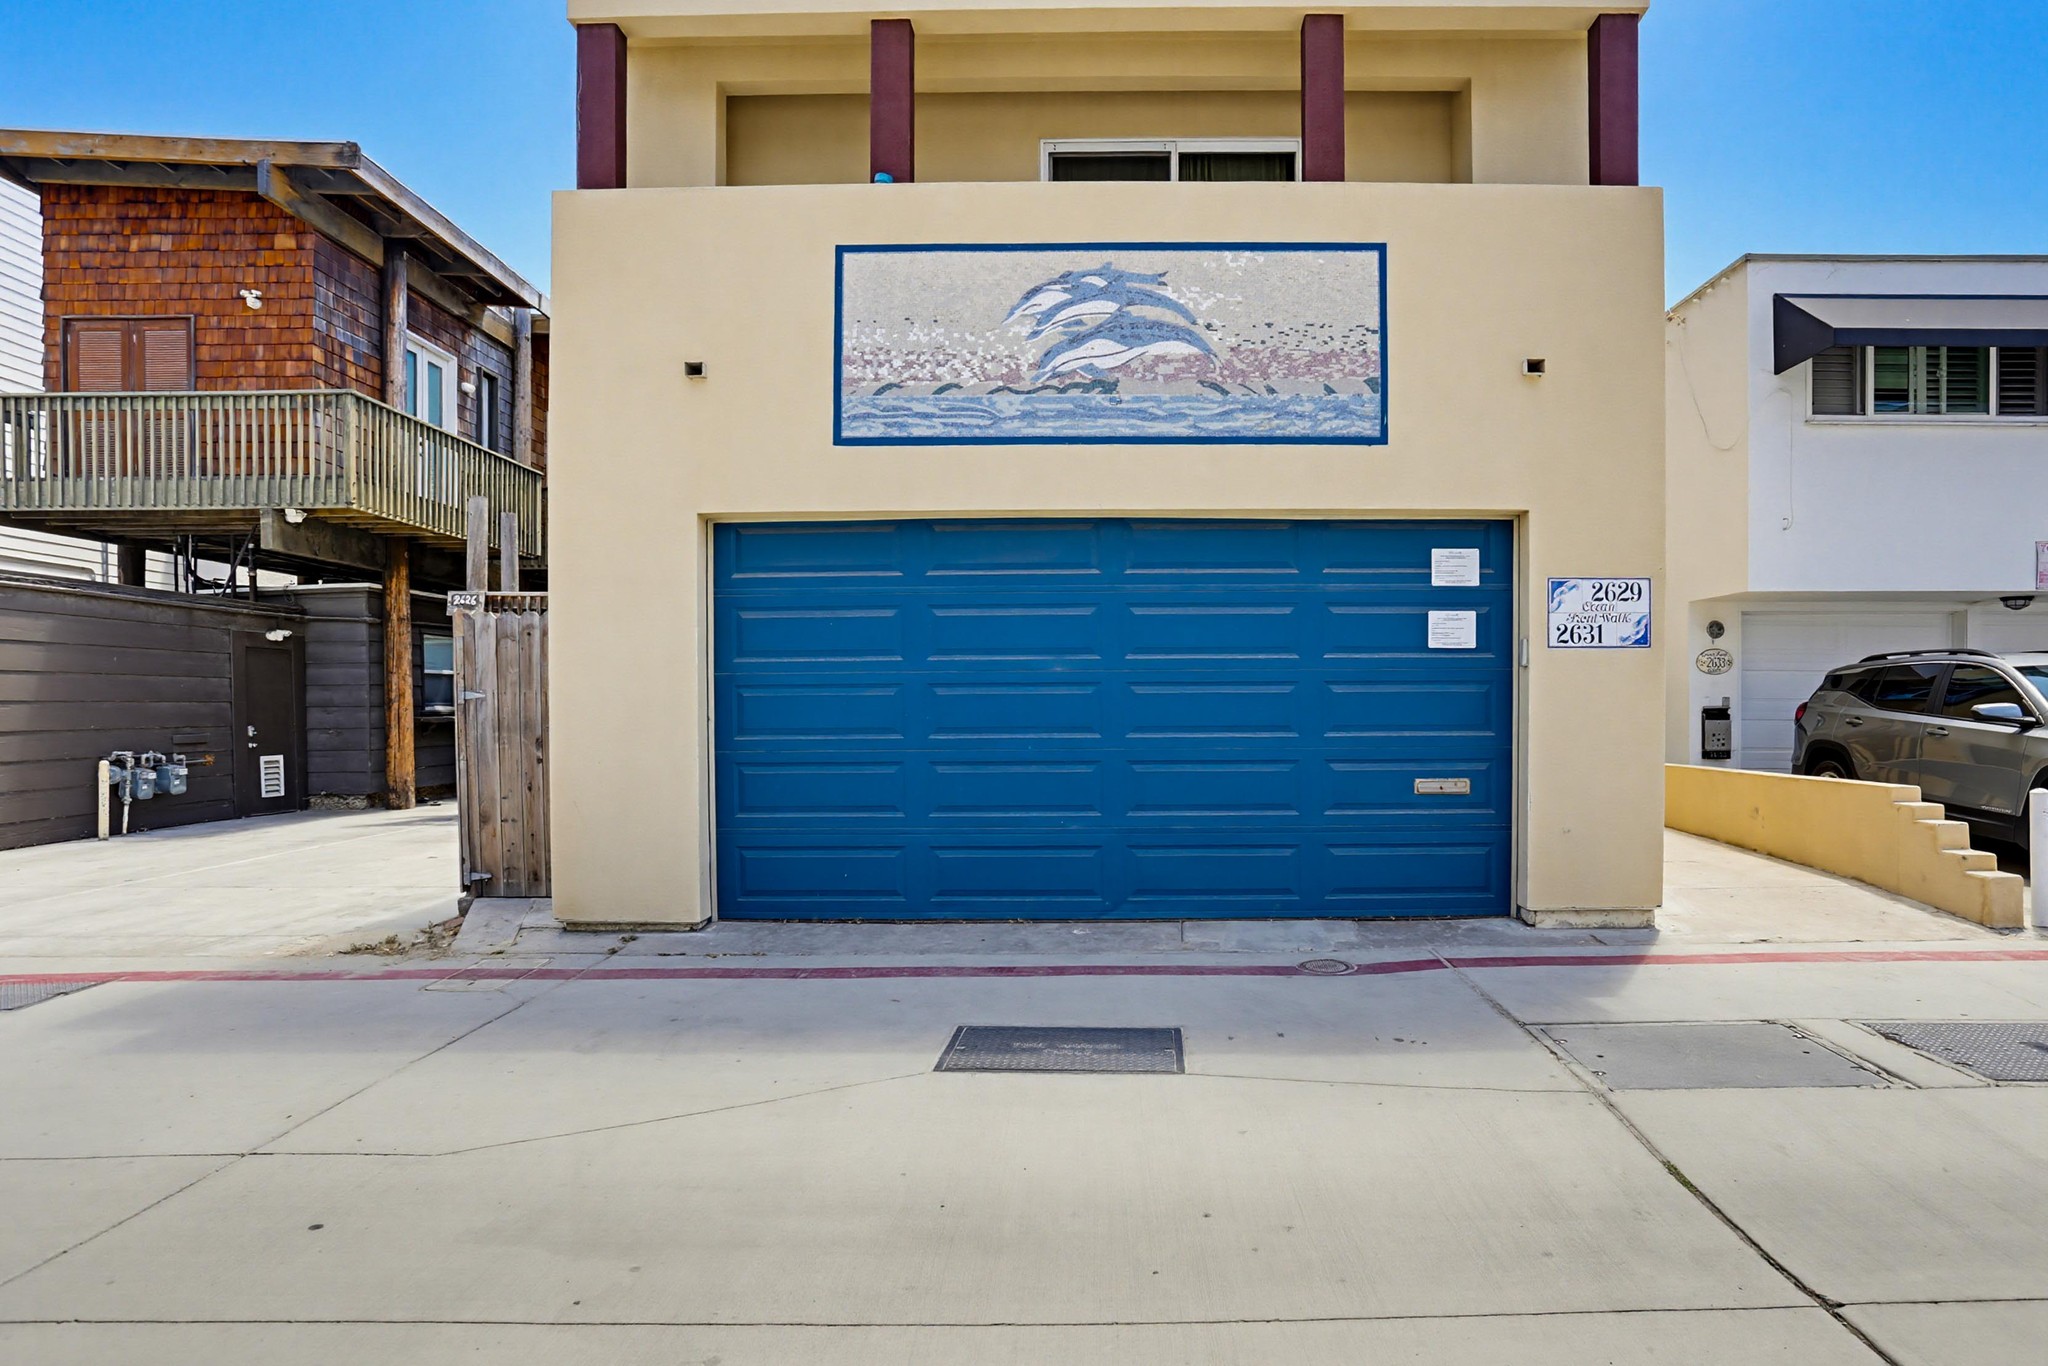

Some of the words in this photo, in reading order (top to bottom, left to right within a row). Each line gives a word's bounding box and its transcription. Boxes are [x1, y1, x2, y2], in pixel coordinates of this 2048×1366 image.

[1591, 581, 1643, 603] 2629
[1582, 601, 1615, 612] Ocean
[1566, 612, 1598, 624] Front
[1599, 612, 1632, 623] Walk
[1556, 623, 1603, 645] 2631
